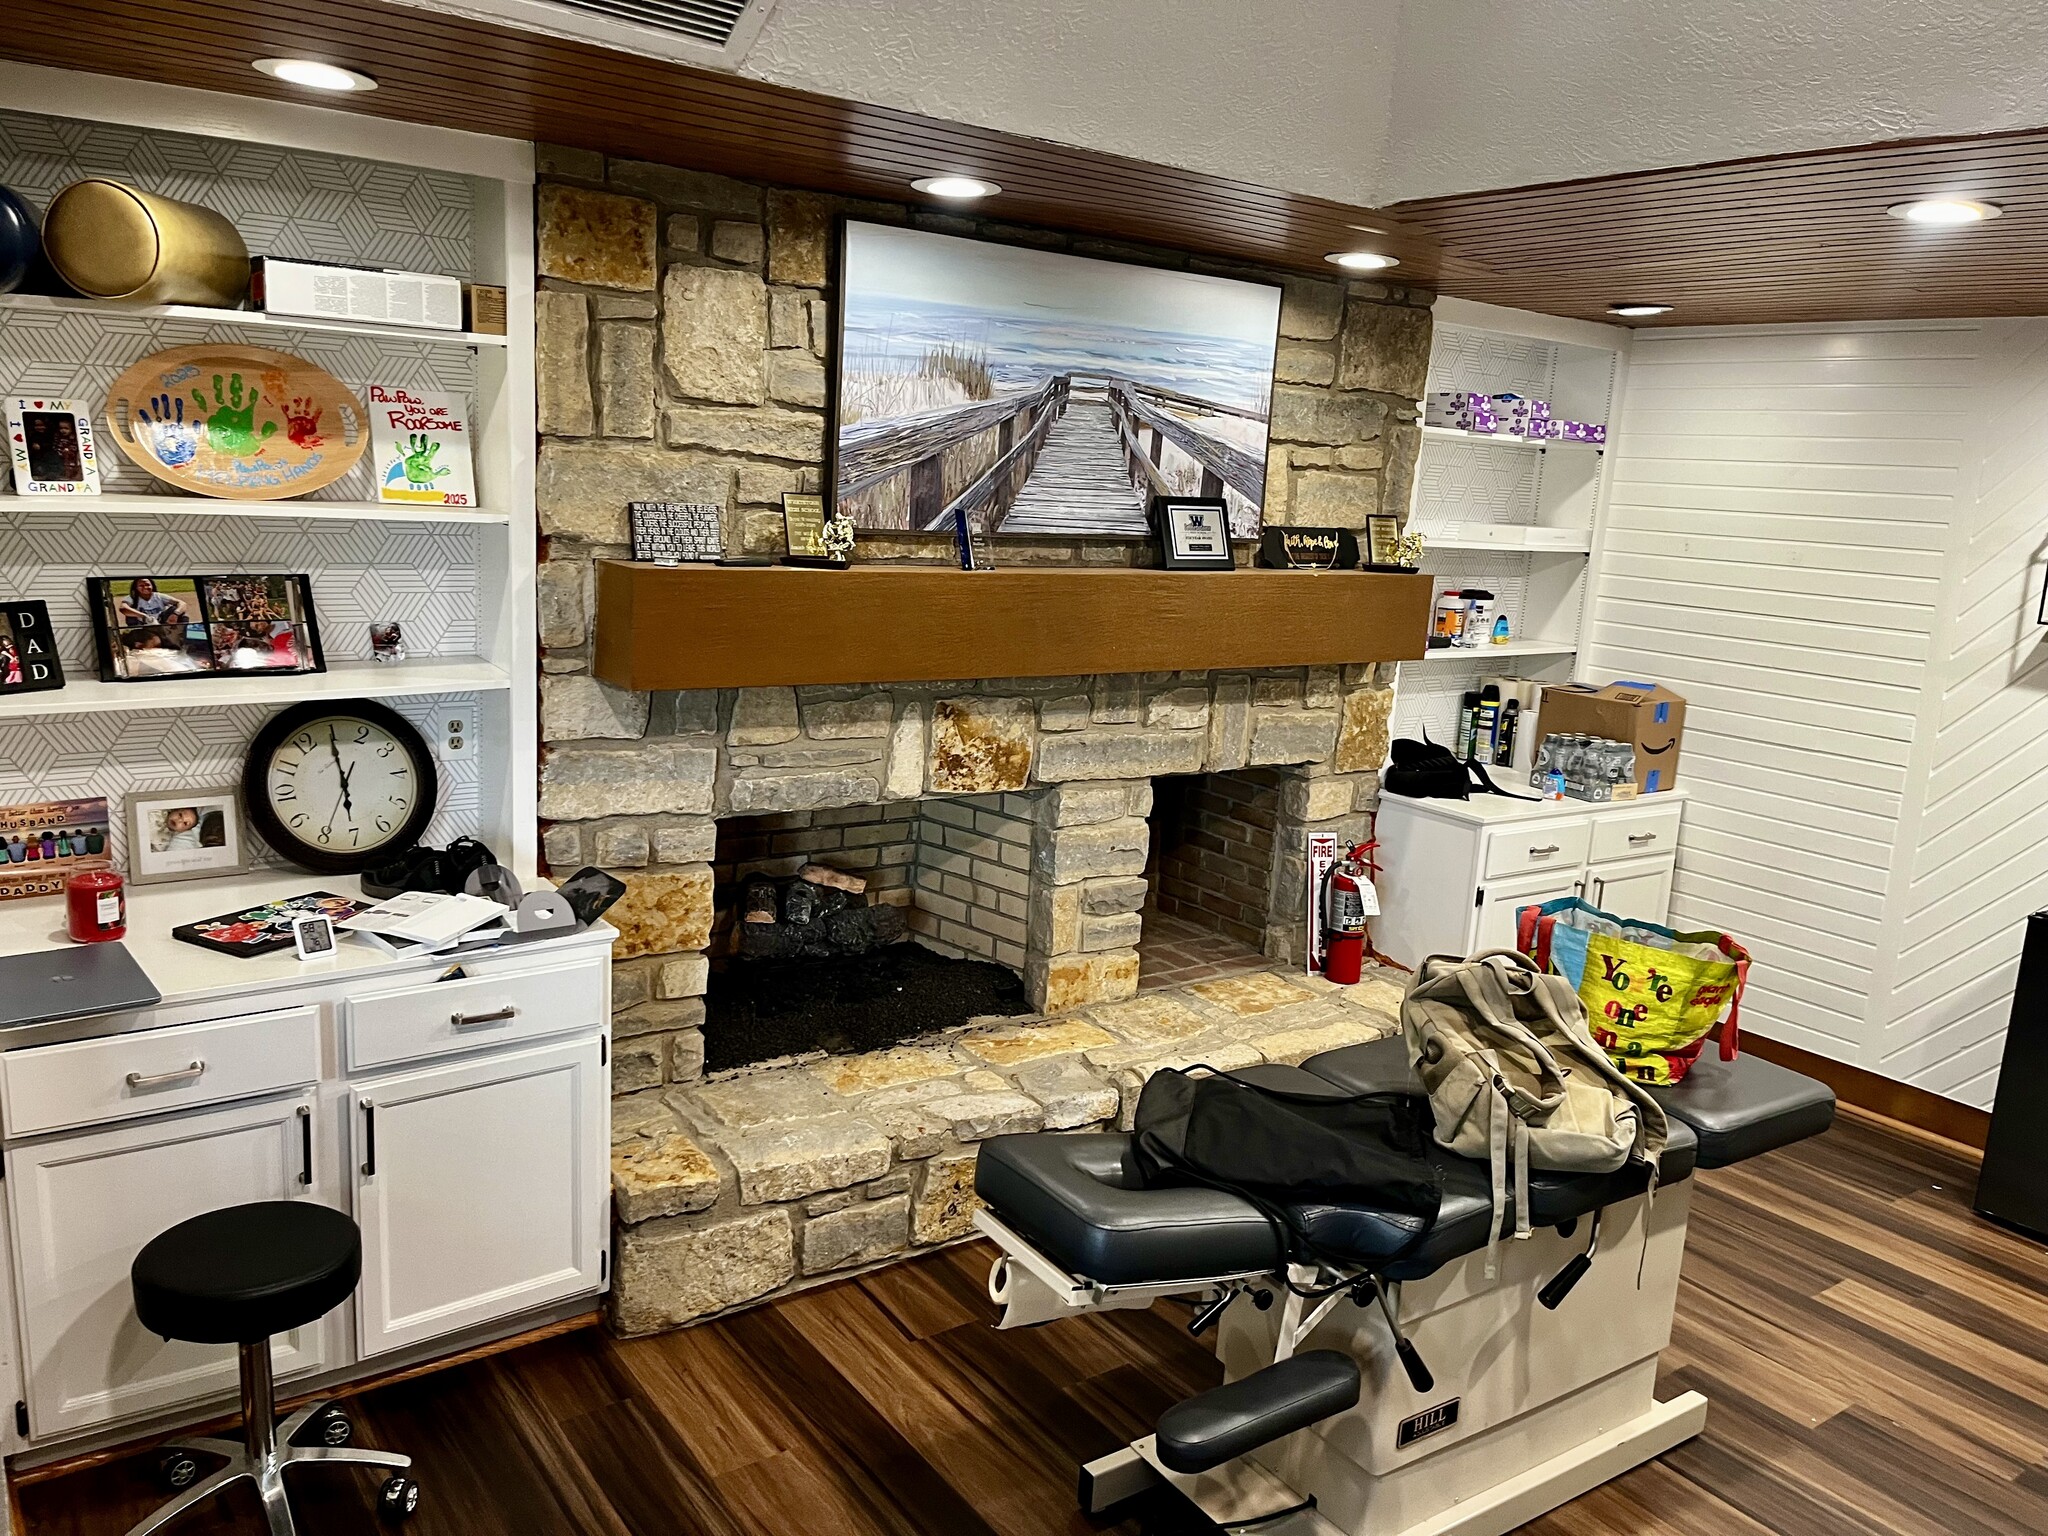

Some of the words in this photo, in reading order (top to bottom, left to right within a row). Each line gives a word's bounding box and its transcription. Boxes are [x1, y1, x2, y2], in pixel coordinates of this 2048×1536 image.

[50, 401, 72, 410] MY
[28, 482, 93, 493] GRANDPA
[443, 493, 468, 505] 2025
[18, 612, 48, 680] DAD
[354, 726, 369, 744] 2
[292, 732, 318, 756] 12
[376, 742, 395, 758] 3
[276, 760, 298, 776] 11
[274, 784, 296, 802] 10
[388, 796, 407, 810] 5
[0, 815, 64, 828] HUSBAND
[290, 812, 310, 828] 9
[376, 815, 392, 832] 6
[317, 826, 332, 844] 8
[348, 828, 359, 846] 7
[1313, 846, 1332, 858] FIRE
[0, 880, 60, 896] DADDY
[1604, 1000, 1648, 1028] one
[1414, 1408, 1447, 1432] HILL
